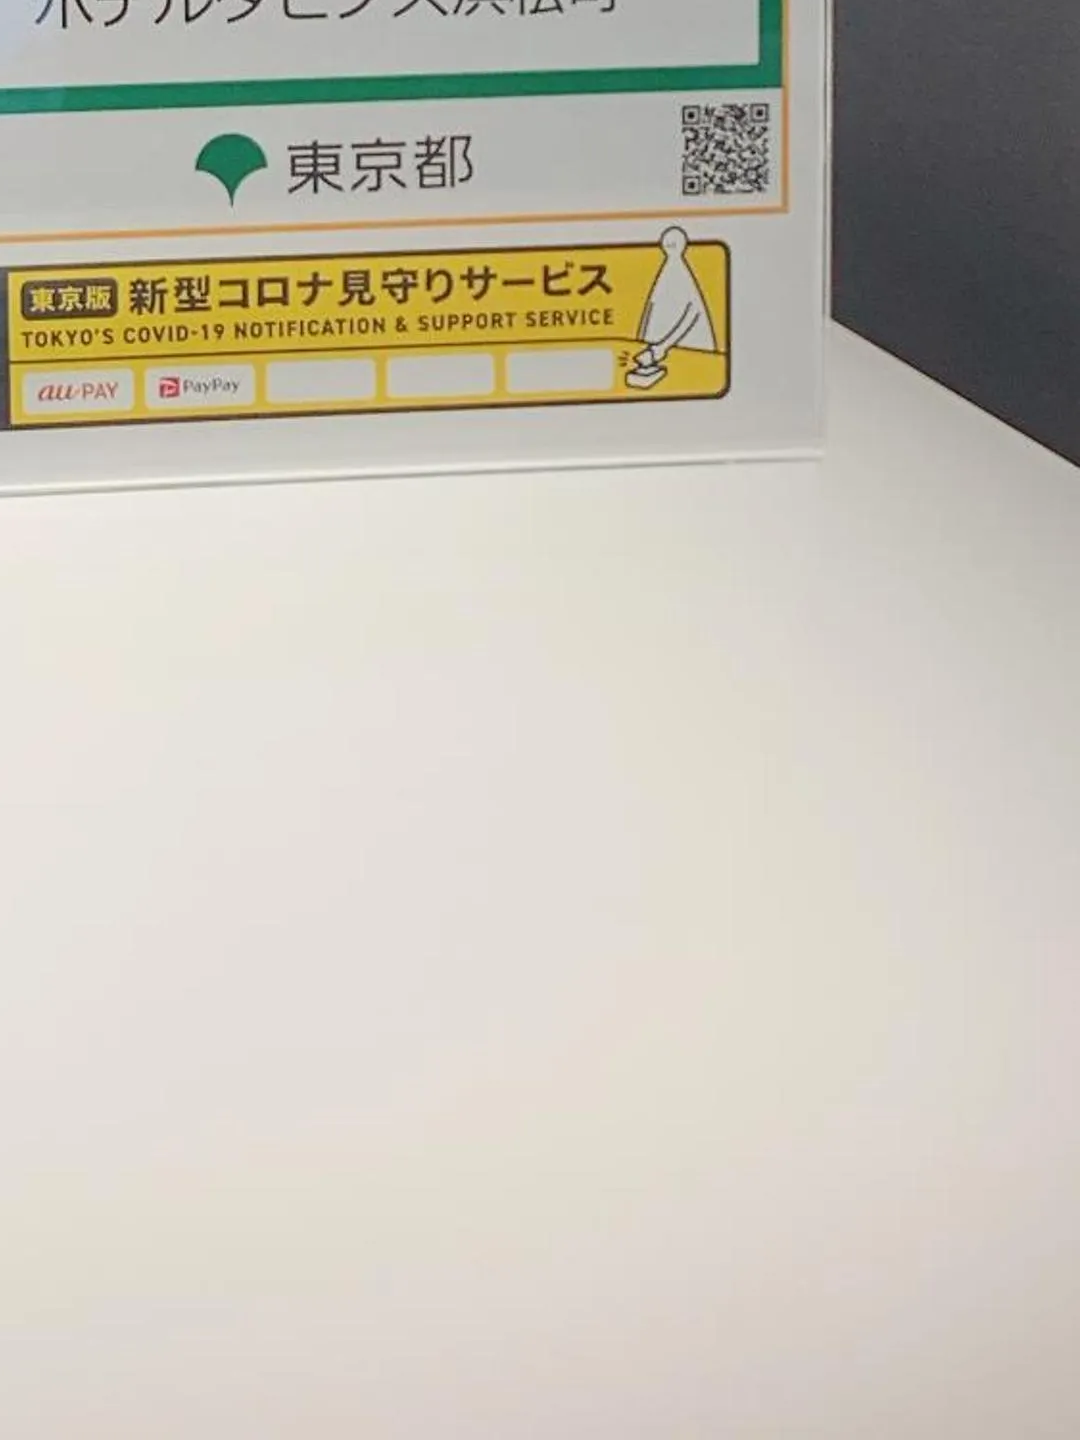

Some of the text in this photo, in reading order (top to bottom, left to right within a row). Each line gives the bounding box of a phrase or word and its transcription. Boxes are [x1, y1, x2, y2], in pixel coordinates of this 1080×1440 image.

[286, 133, 474, 196] 東京都
[29, 284, 113, 313] 東京版
[128, 262, 614, 315] 新型コロナ見守りサービス
[21, 308, 615, 350] TOKYO'S COVID-19 NOTIFICATION & SUPPORT SERVICE
[182, 378, 241, 396] PayPay
